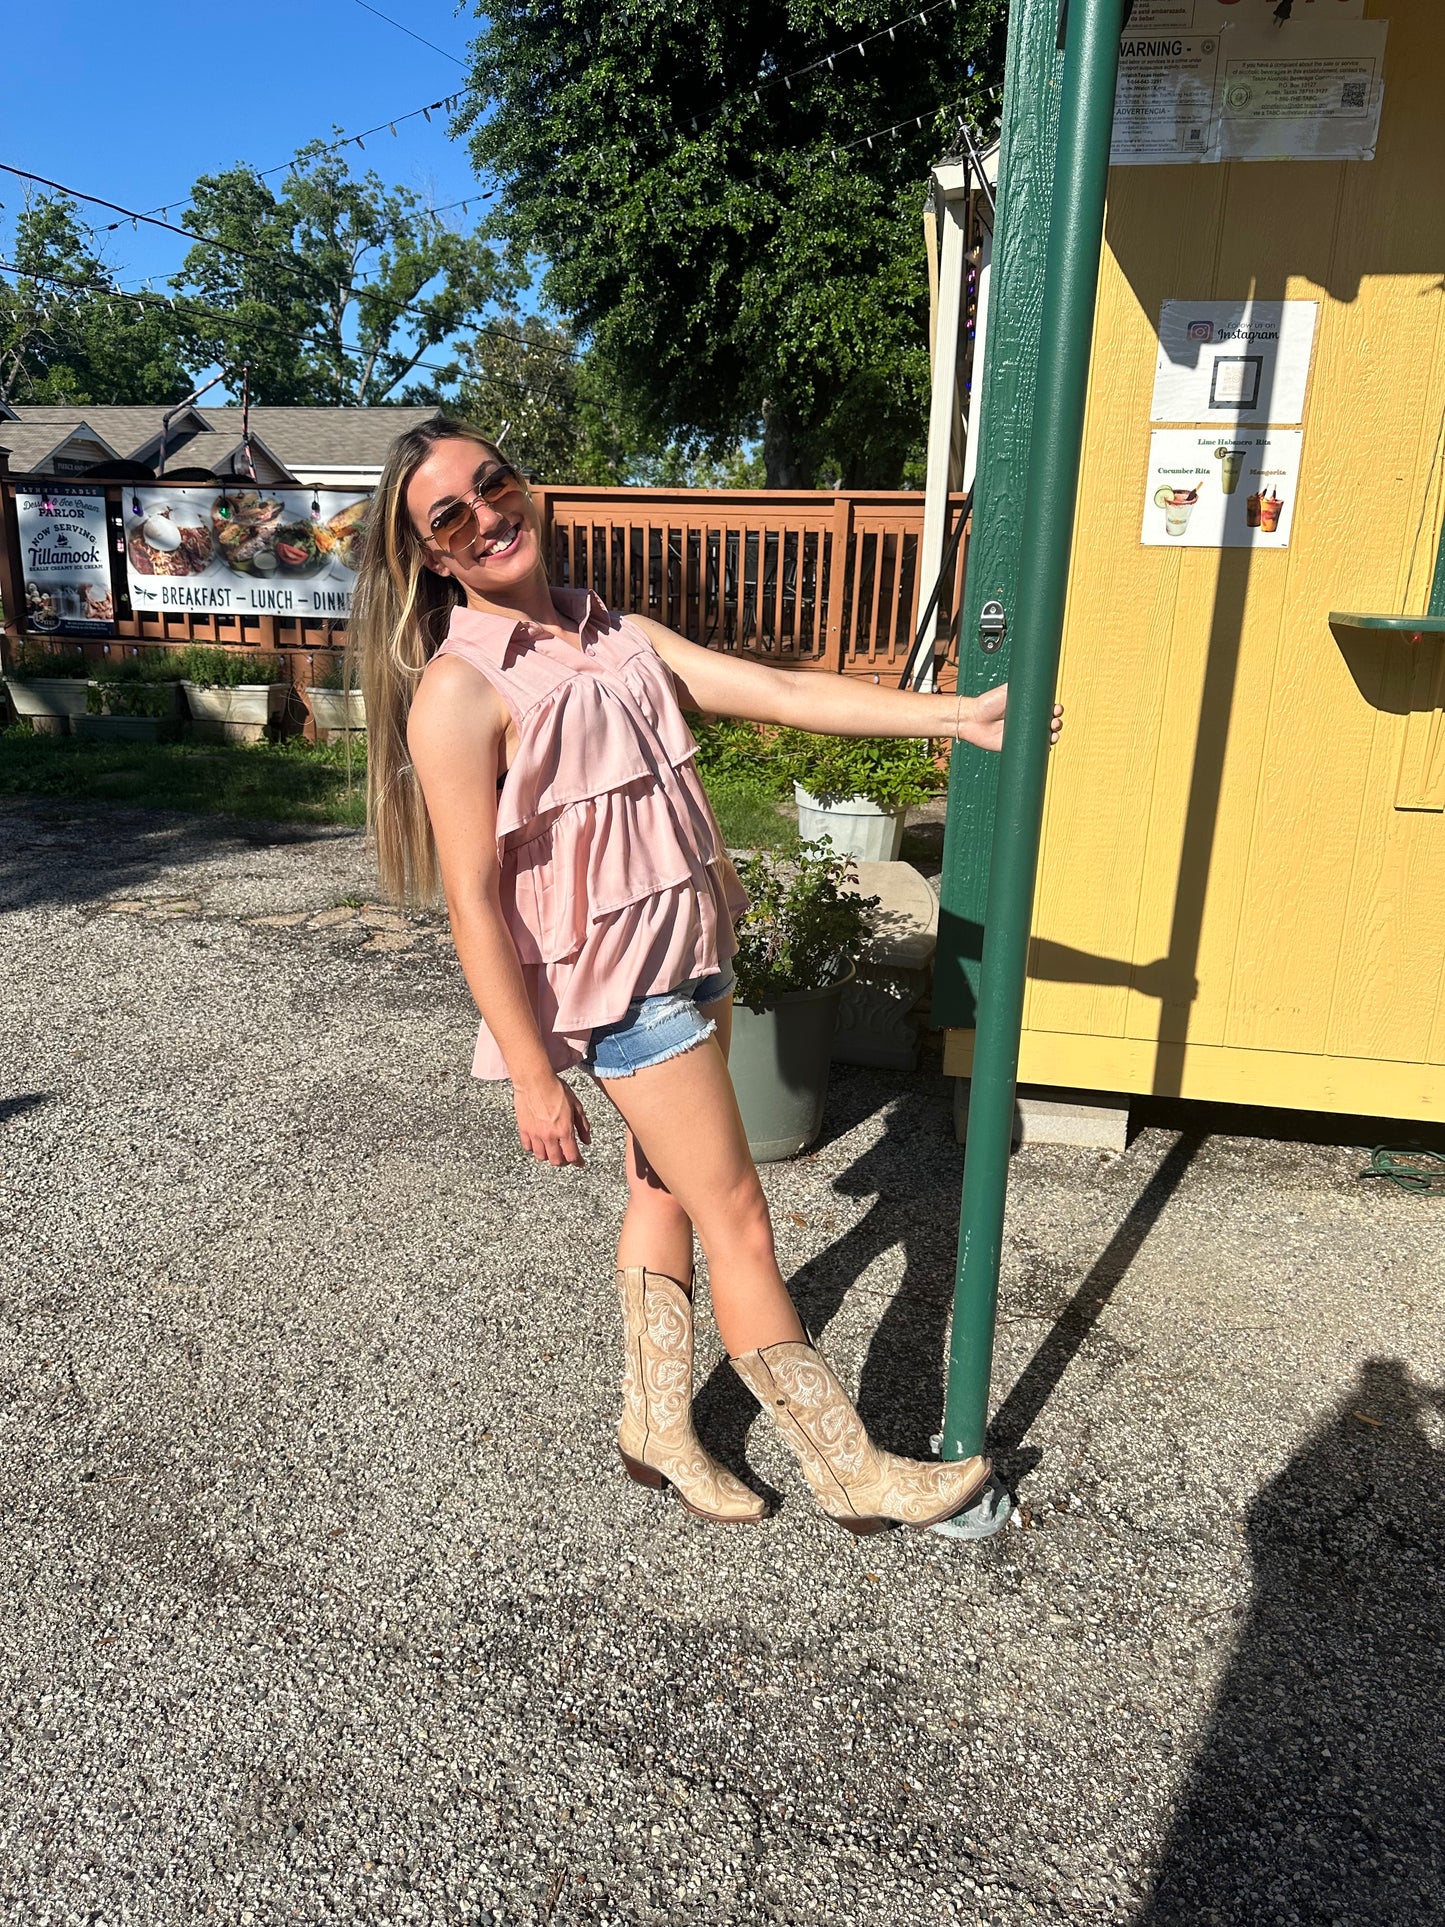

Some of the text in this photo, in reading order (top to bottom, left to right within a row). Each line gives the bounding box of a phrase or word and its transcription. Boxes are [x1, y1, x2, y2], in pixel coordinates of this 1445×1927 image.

[1228, 321, 1251, 329] Follow
[1218, 329, 1280, 344] Instagram
[1158, 467, 1211, 475] Cucumber Rita
[1250, 469, 1287, 477] Mangorita
[38, 508, 86, 518] PARLOR
[59, 497, 74, 507] Ice
[74, 498, 100, 514] Cream
[31, 527, 51, 547] NOW
[28, 546, 100, 567] Tillamook
[162, 586, 231, 607] BREAKFAST
[251, 589, 293, 609] LUNCH
[313, 591, 353, 611] DINNE
